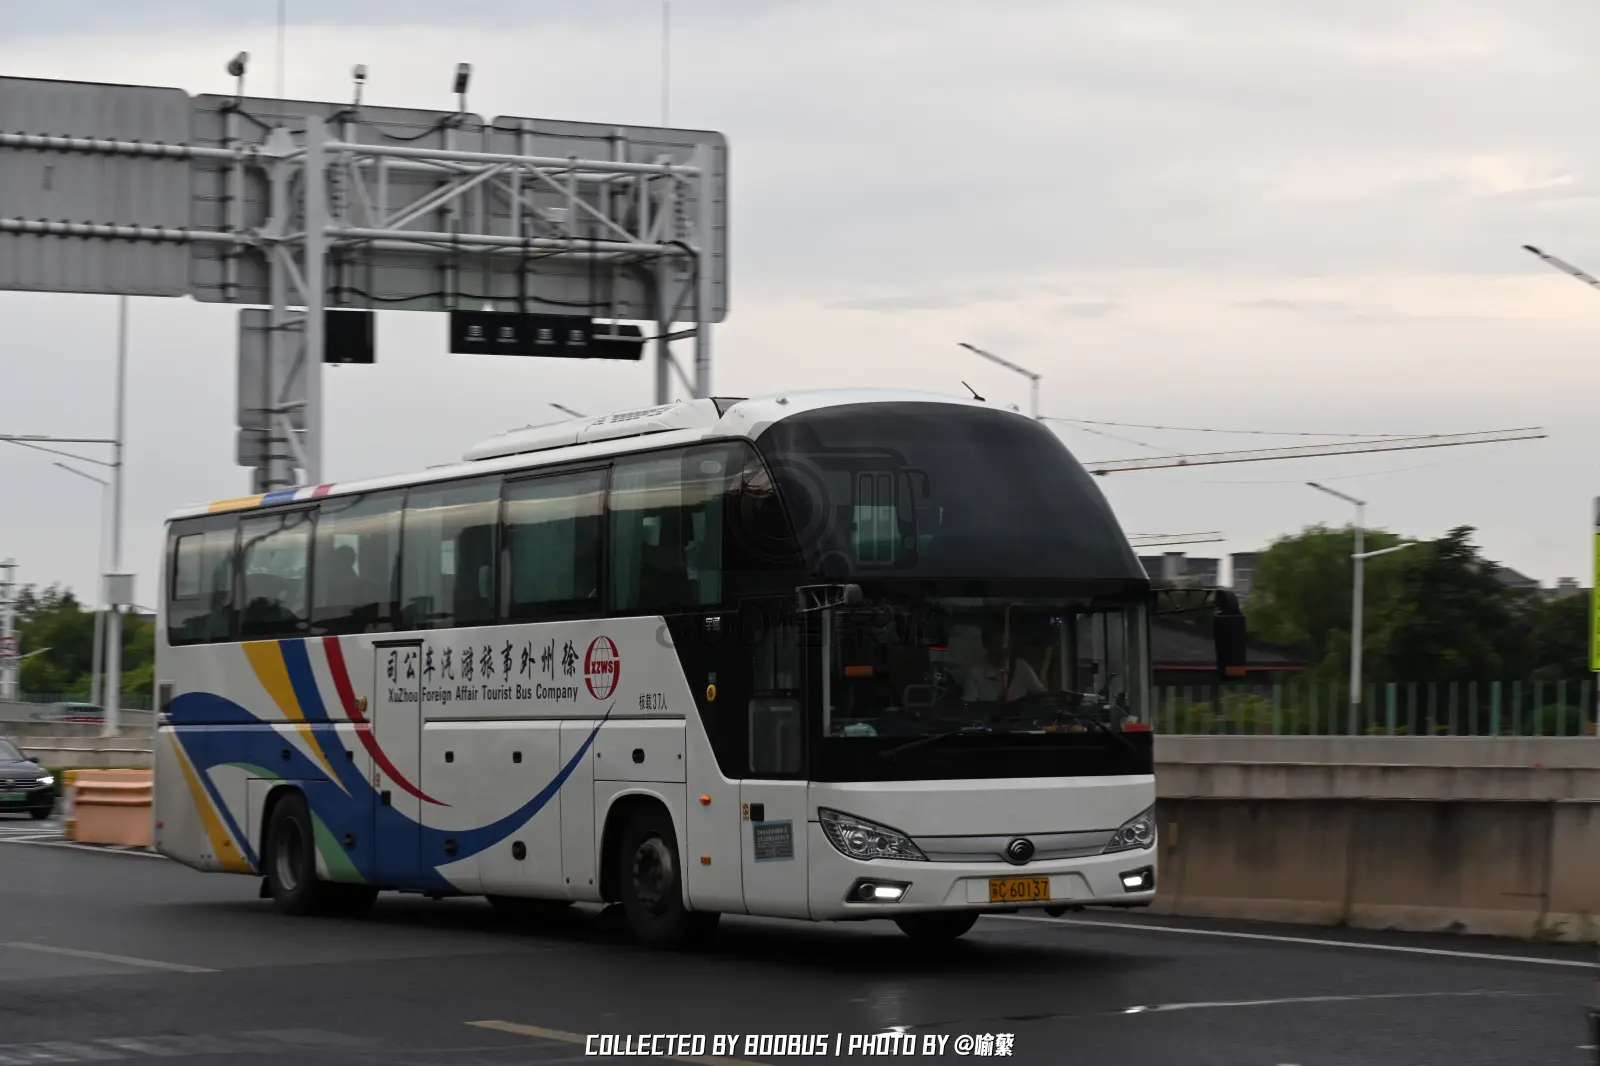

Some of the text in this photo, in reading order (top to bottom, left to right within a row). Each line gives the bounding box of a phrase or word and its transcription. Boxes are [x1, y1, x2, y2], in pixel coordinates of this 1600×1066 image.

[591, 660, 613, 675] XZWS
[388, 683, 579, 705] XuZhou Foreign Affair Tourist Bus Company
